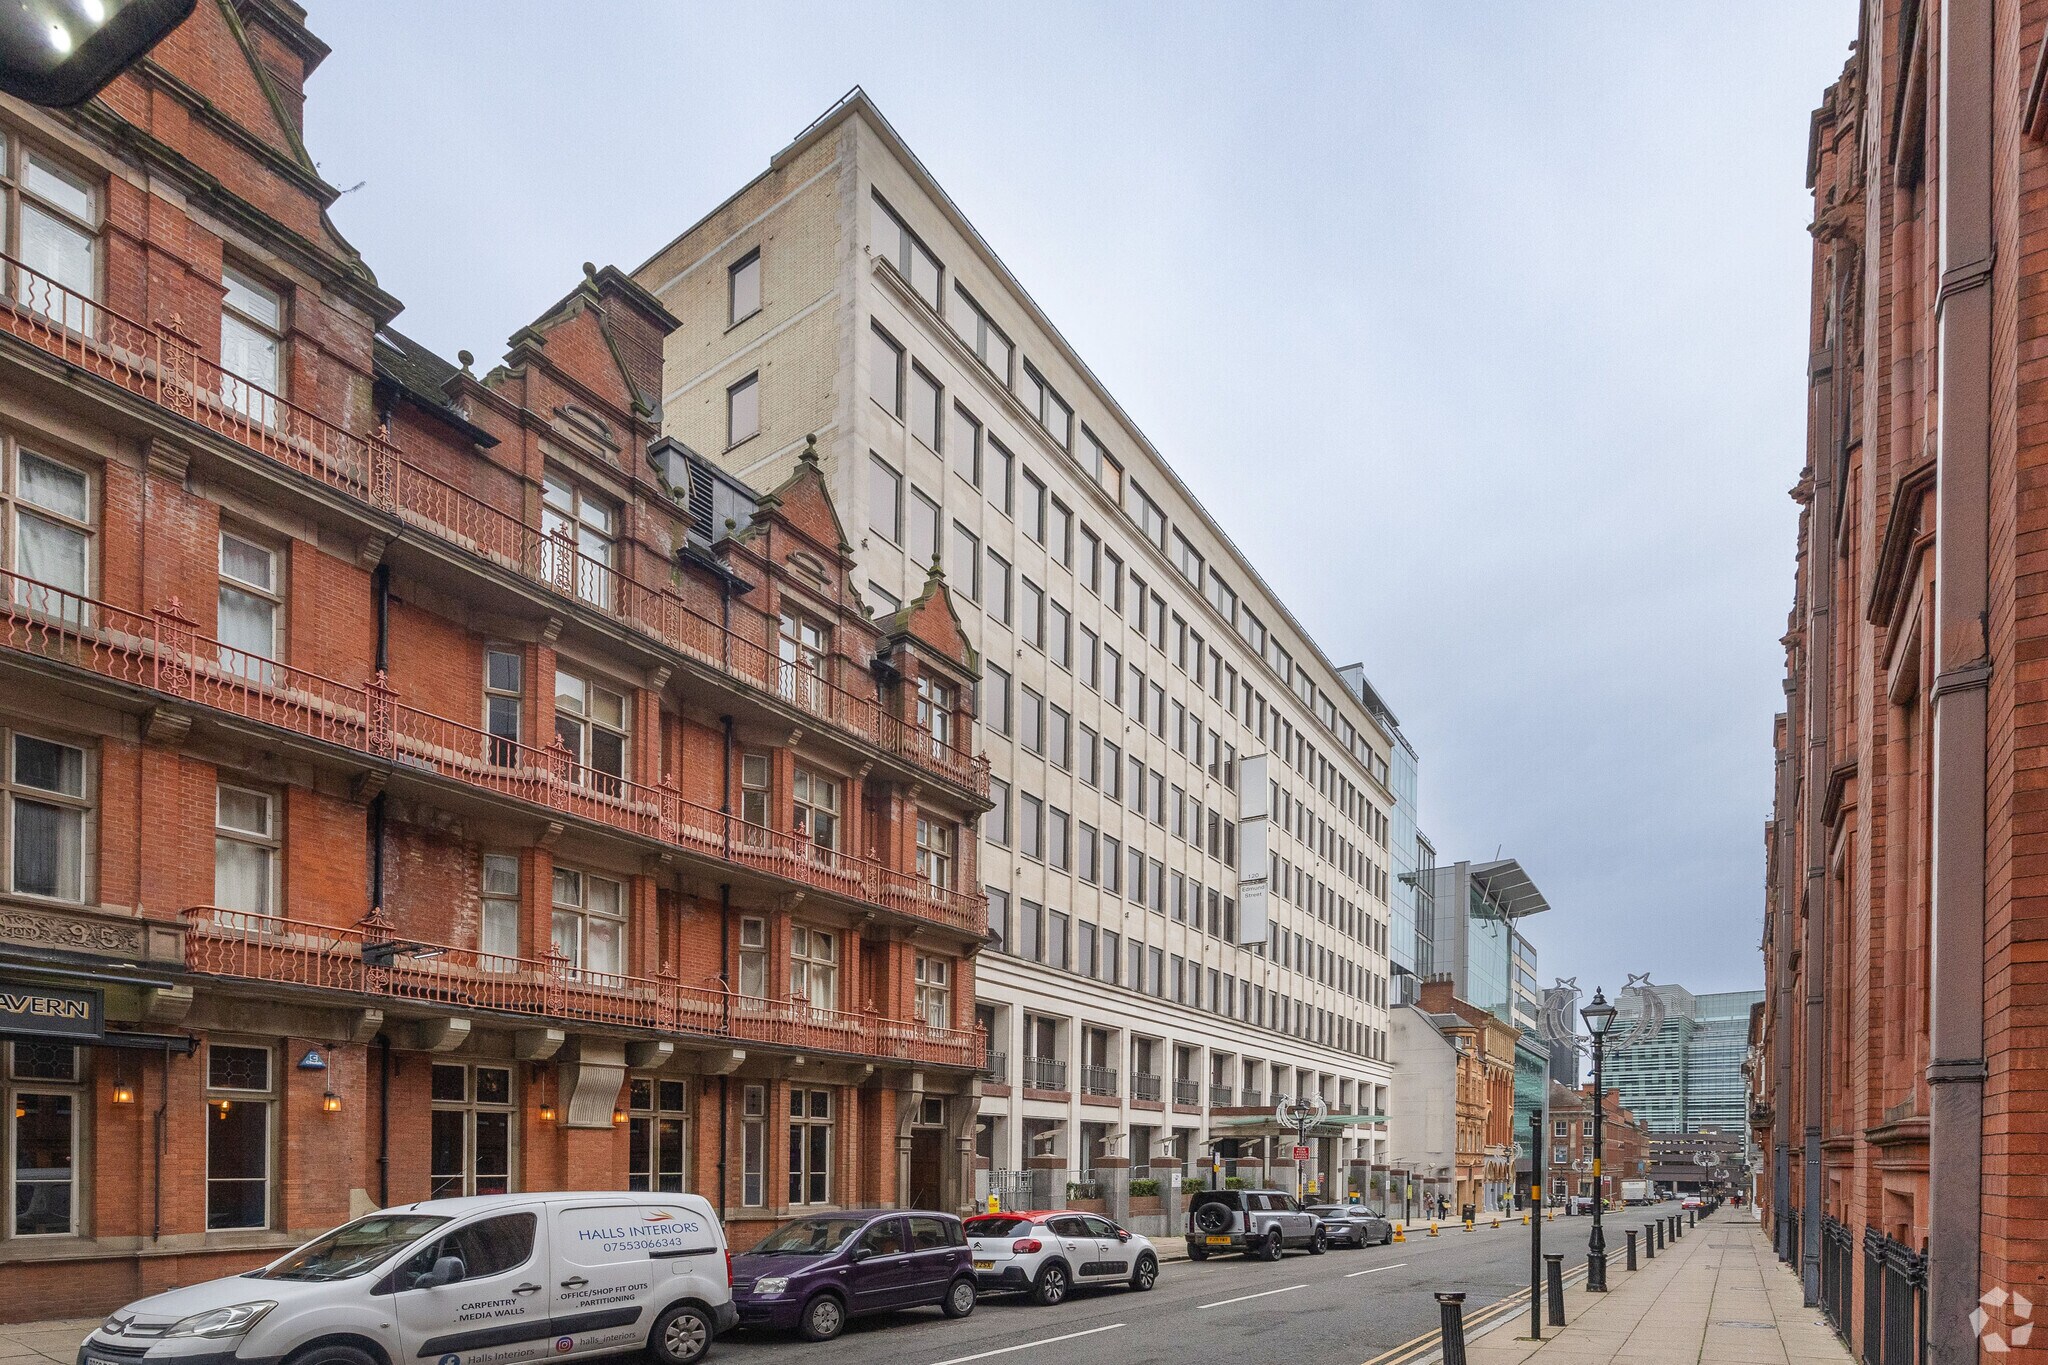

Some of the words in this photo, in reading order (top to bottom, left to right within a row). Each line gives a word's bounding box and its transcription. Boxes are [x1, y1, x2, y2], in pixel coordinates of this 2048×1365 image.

[578, 1227, 625, 1241] HALLS
[629, 1222, 699, 1237] INTERIORS
[603, 1237, 682, 1252] 07553066343
[560, 1287, 614, 1300] OFFICE/SHOP
[615, 1285, 626, 1293] FIT
[628, 1282, 648, 1291] OUTS
[461, 1298, 517, 1311] CARPENTRY
[580, 1294, 635, 1308] PARTITIONING
[459, 1312, 492, 1322] MEDIA
[494, 1307, 525, 1317] WALLS
[580, 1332, 636, 1346] halls_interiors
[467, 1354, 492, 1365] Halls
[494, 1348, 535, 1360] Interiors
